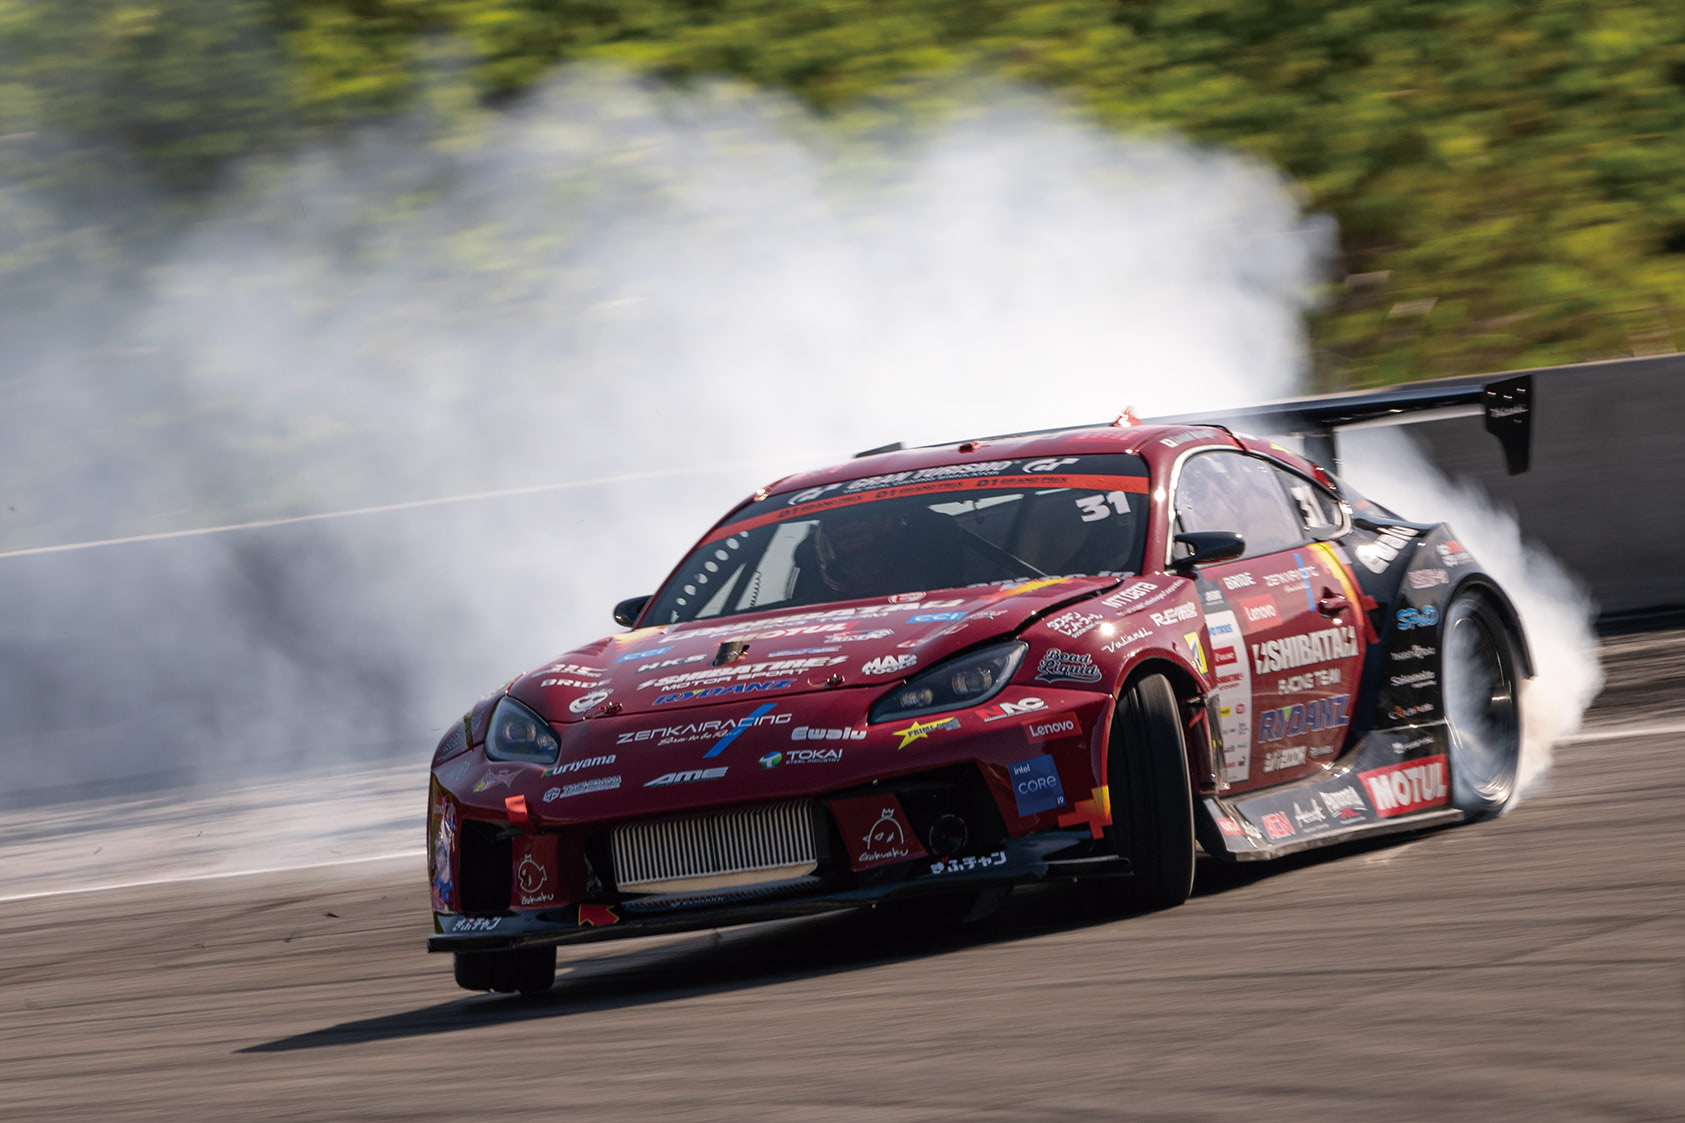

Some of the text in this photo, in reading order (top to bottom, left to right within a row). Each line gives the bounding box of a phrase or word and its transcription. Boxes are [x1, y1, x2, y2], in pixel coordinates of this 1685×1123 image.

[1075, 490, 1132, 523] 31
[1222, 571, 1256, 590] BRIDE
[1244, 604, 1277, 622] Lenovo
[637, 654, 707, 673] HKS
[1044, 648, 1093, 665] Bead
[1038, 659, 1101, 677] Liquid
[661, 667, 809, 692] MOTOR SPORT
[653, 679, 797, 705] RYDANZ
[1029, 719, 1074, 737] Lenovo
[1258, 694, 1350, 744] RYDANZ
[786, 749, 843, 761] TOKAI
[1014, 763, 1031, 775] intel
[1367, 762, 1448, 811] MOTUL
[930, 850, 1008, 875] ぎふチャン
